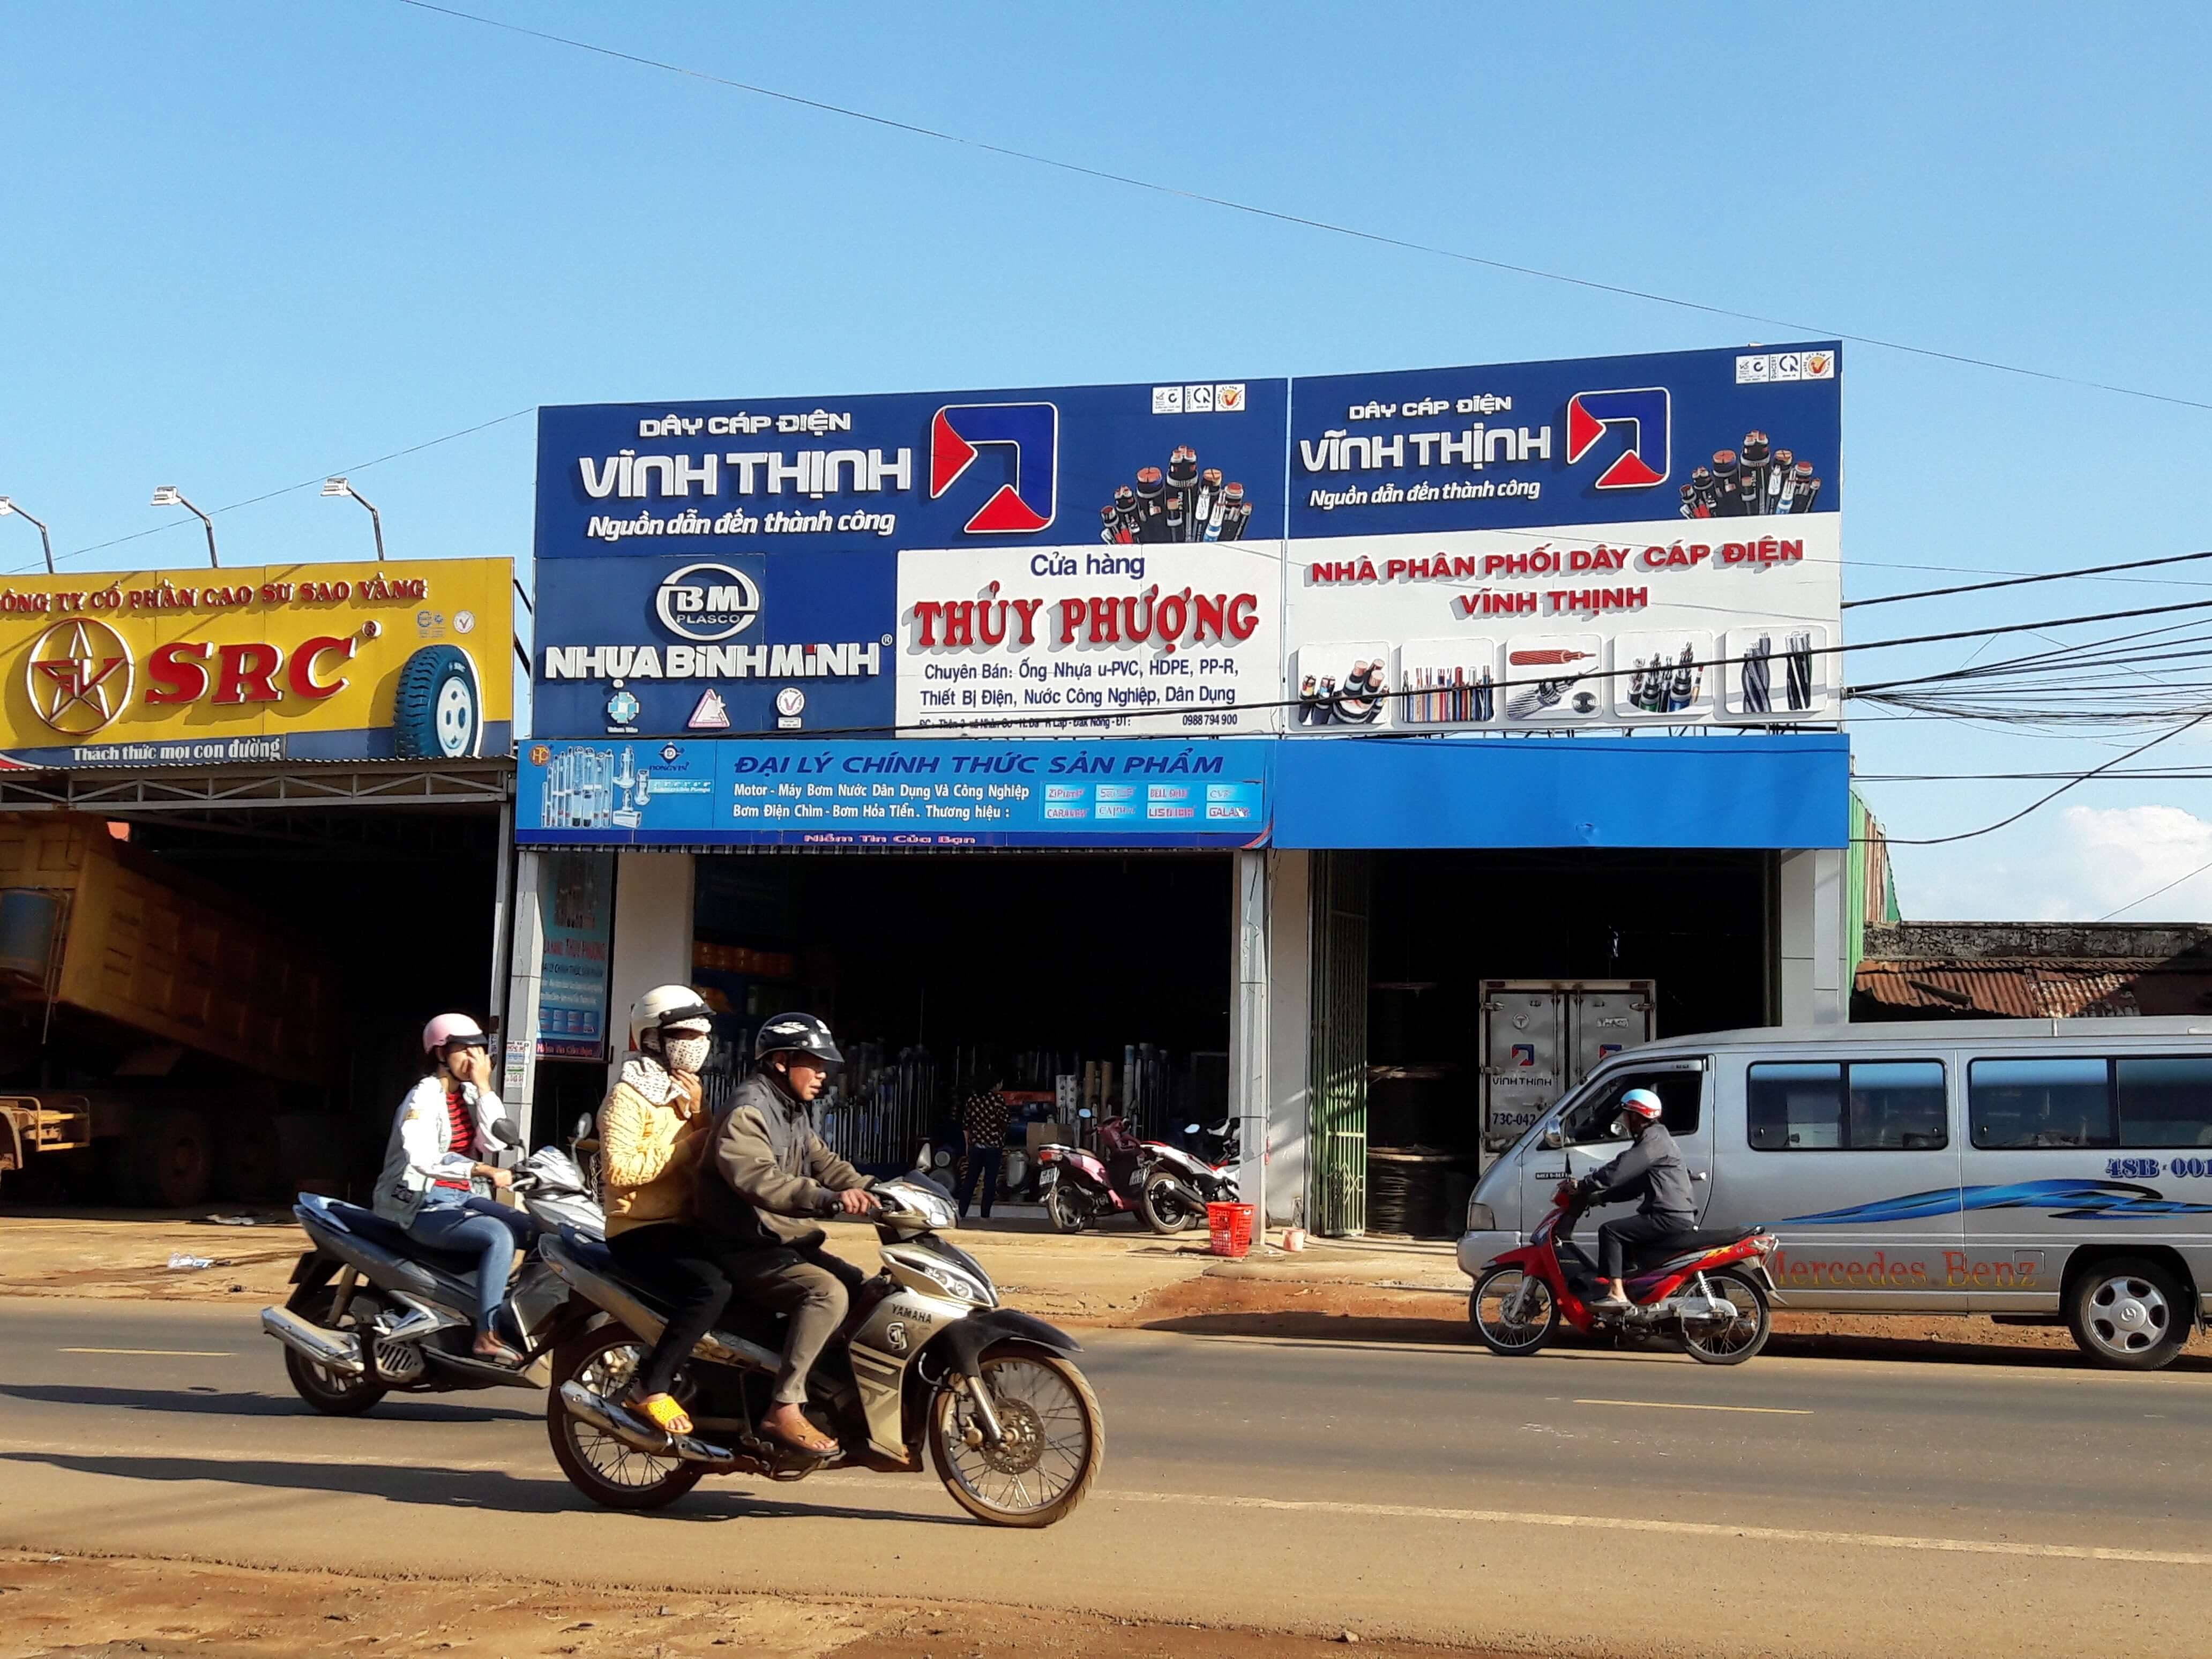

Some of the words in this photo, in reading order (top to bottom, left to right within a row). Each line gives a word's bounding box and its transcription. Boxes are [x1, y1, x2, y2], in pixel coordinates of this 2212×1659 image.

[1349, 401, 1396, 420] DÂY
[1402, 397, 1449, 417] CÁP
[1455, 393, 1512, 415] ĐIỆN
[639, 414, 703, 437] DÂY
[708, 412, 772, 435] CÁP
[775, 409, 851, 436] ĐIỆN
[1299, 428, 1403, 472] VĨNH
[1409, 422, 1551, 470] THỊNH
[578, 449, 718, 498] VĨNH
[726, 447, 911, 499] THỊNH
[1309, 485, 1367, 511] Nguồn
[1371, 483, 1403, 504] dẫn
[1407, 480, 1440, 502] đến
[1442, 480, 1494, 499] thành
[1497, 479, 1541, 500] công
[587, 510, 663, 542] Nguồn
[667, 507, 709, 535] dẫn
[714, 507, 757, 534] đến
[764, 509, 832, 533] thành
[838, 510, 895, 535] công
[1030, 551, 1077, 577] Cửa
[1086, 555, 1146, 580] hàng
[1312, 555, 1378, 582] NHÀ
[1387, 551, 1475, 579] PHÂN
[1485, 542, 1560, 574] PHỐI
[1570, 543, 1632, 571] DÂY
[1643, 539, 1711, 566] CÁP
[1722, 535, 1804, 567] ĐIỆN
[0, 588, 52, 612] ÔNG
[55, 591, 88, 612] TY
[129, 578, 200, 610] PHẦN
[204, 584, 255, 608] CAO
[262, 582, 296, 603] SU
[300, 580, 353, 602] SAO
[357, 571, 429, 601] VÀNG
[1460, 587, 1537, 614] VĨNH
[1547, 586, 1648, 615] THỊNH
[676, 614, 740, 624] PLASCO
[1059, 584, 1259, 653] PHƯỢNG
[545, 645, 663, 689] NHỰA
[924, 663, 978, 683] Chuyên
[981, 661, 1013, 679] Bán:
[1019, 657, 1048, 682] Ống
[1053, 661, 1092, 679] Nhựa
[1097, 660, 1144, 678] u-PVC,
[1149, 659, 1194, 678] HDPE,
[1199, 657, 1239, 677] PP-R,
[920, 688, 956, 706] Thiết
[962, 689, 977, 708] Bị
[981, 688, 1017, 708] Điện,
[1024, 688, 1061, 705] Nước
[1066, 687, 1103, 707] Công
[1108, 686, 1161, 707] Nghiệp,
[1165, 686, 1195, 703] Dân
[1199, 685, 1236, 705] Dụng
[1182, 714, 1203, 726] 0988
[1205, 714, 1220, 725] 794
[1221, 713, 1238, 725] 900
[72, 746, 120, 761] Thách
[122, 744, 156, 760] thức
[193, 744, 224, 759] con
[228, 738, 281, 761] đường
[734, 756, 791, 778] ĐẠI
[796, 751, 834, 773] LÝ
[842, 751, 940, 773] CHÍNH
[952, 751, 1040, 774] THỨC
[1048, 750, 1116, 774] SẢN
[1123, 747, 1224, 774] PHẨM
[734, 783, 768, 797] Motor
[778, 783, 802, 800] Máy
[807, 783, 833, 797] Bơm
[838, 783, 868, 798] Nước
[872, 783, 895, 797] Dân
[900, 783, 931, 801] Dụng
[935, 783, 950, 798] Và
[953, 783, 984, 801] Công
[988, 783, 1030, 802] Nghiệp
[733, 804, 759, 818] Bơm
[763, 804, 790, 821] Điện
[832, 804, 858, 818] Bơm
[862, 803, 886, 818] Hỏa
[925, 804, 971, 821] Thương
[975, 804, 1001, 822] hiệu
[859, 834, 887, 843] Tin
[937, 835, 976, 846] Bạn
[2105, 1157, 2161, 1178] 48B
[1941, 1251, 2038, 1287] Benz
[892, 1303, 932, 1324] YAMAHA
